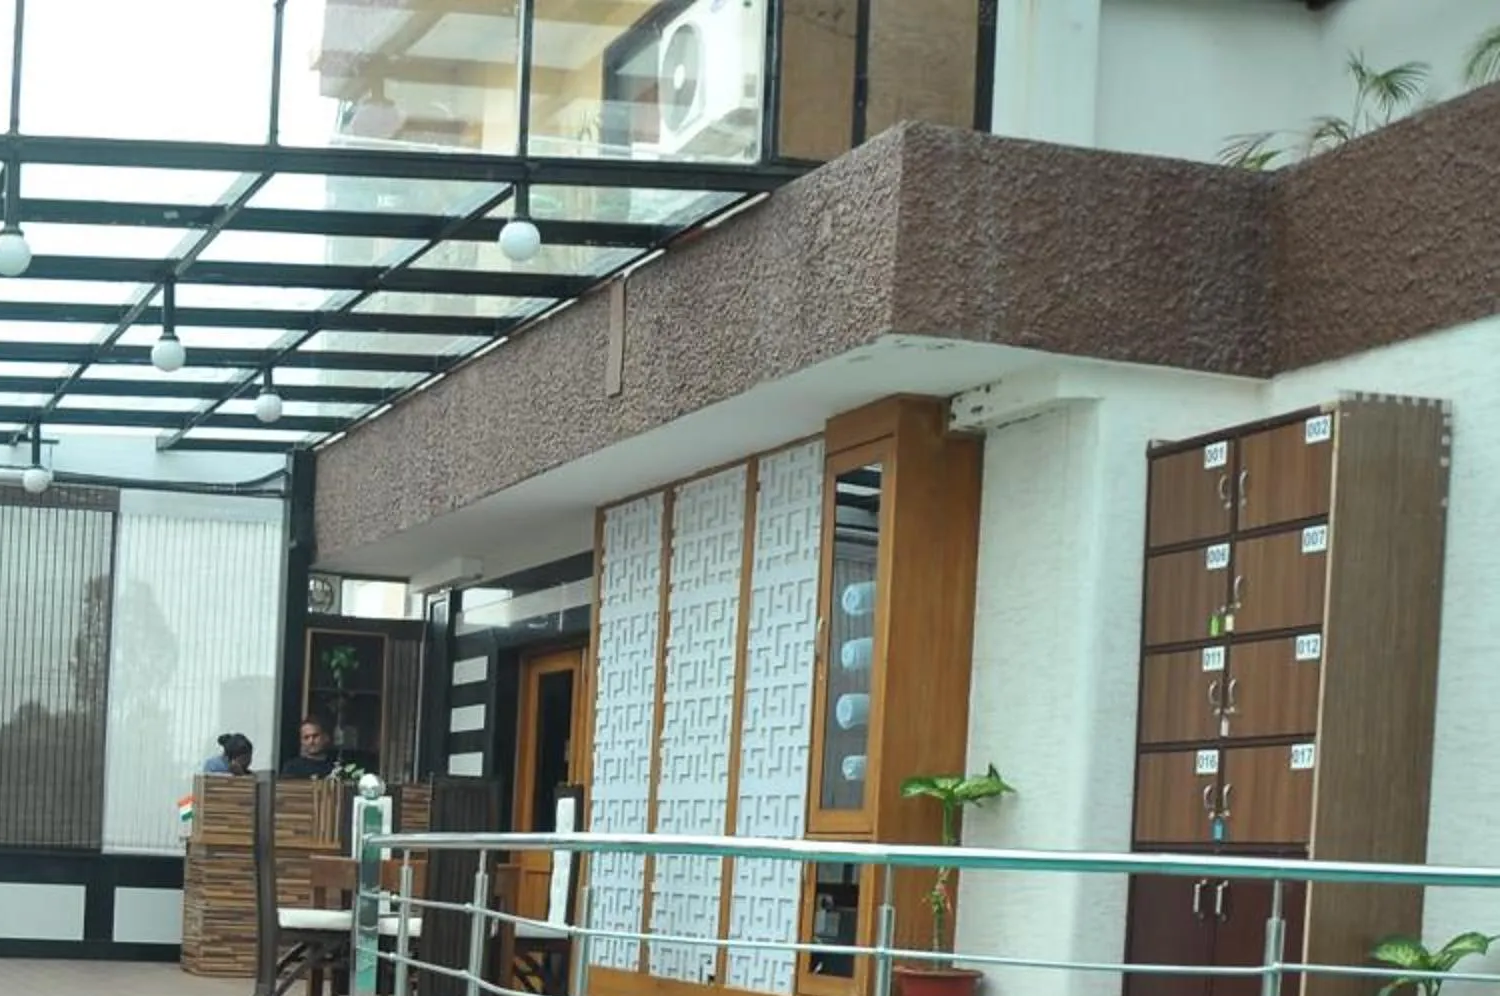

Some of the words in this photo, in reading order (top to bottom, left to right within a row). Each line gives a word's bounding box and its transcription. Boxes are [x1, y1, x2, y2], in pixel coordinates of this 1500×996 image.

[1307, 419, 1328, 436] 002
[1304, 529, 1325, 545] 007
[1298, 639, 1318, 654] 012
[1204, 652, 1221, 666] 011
[1293, 748, 1313, 763] 017
